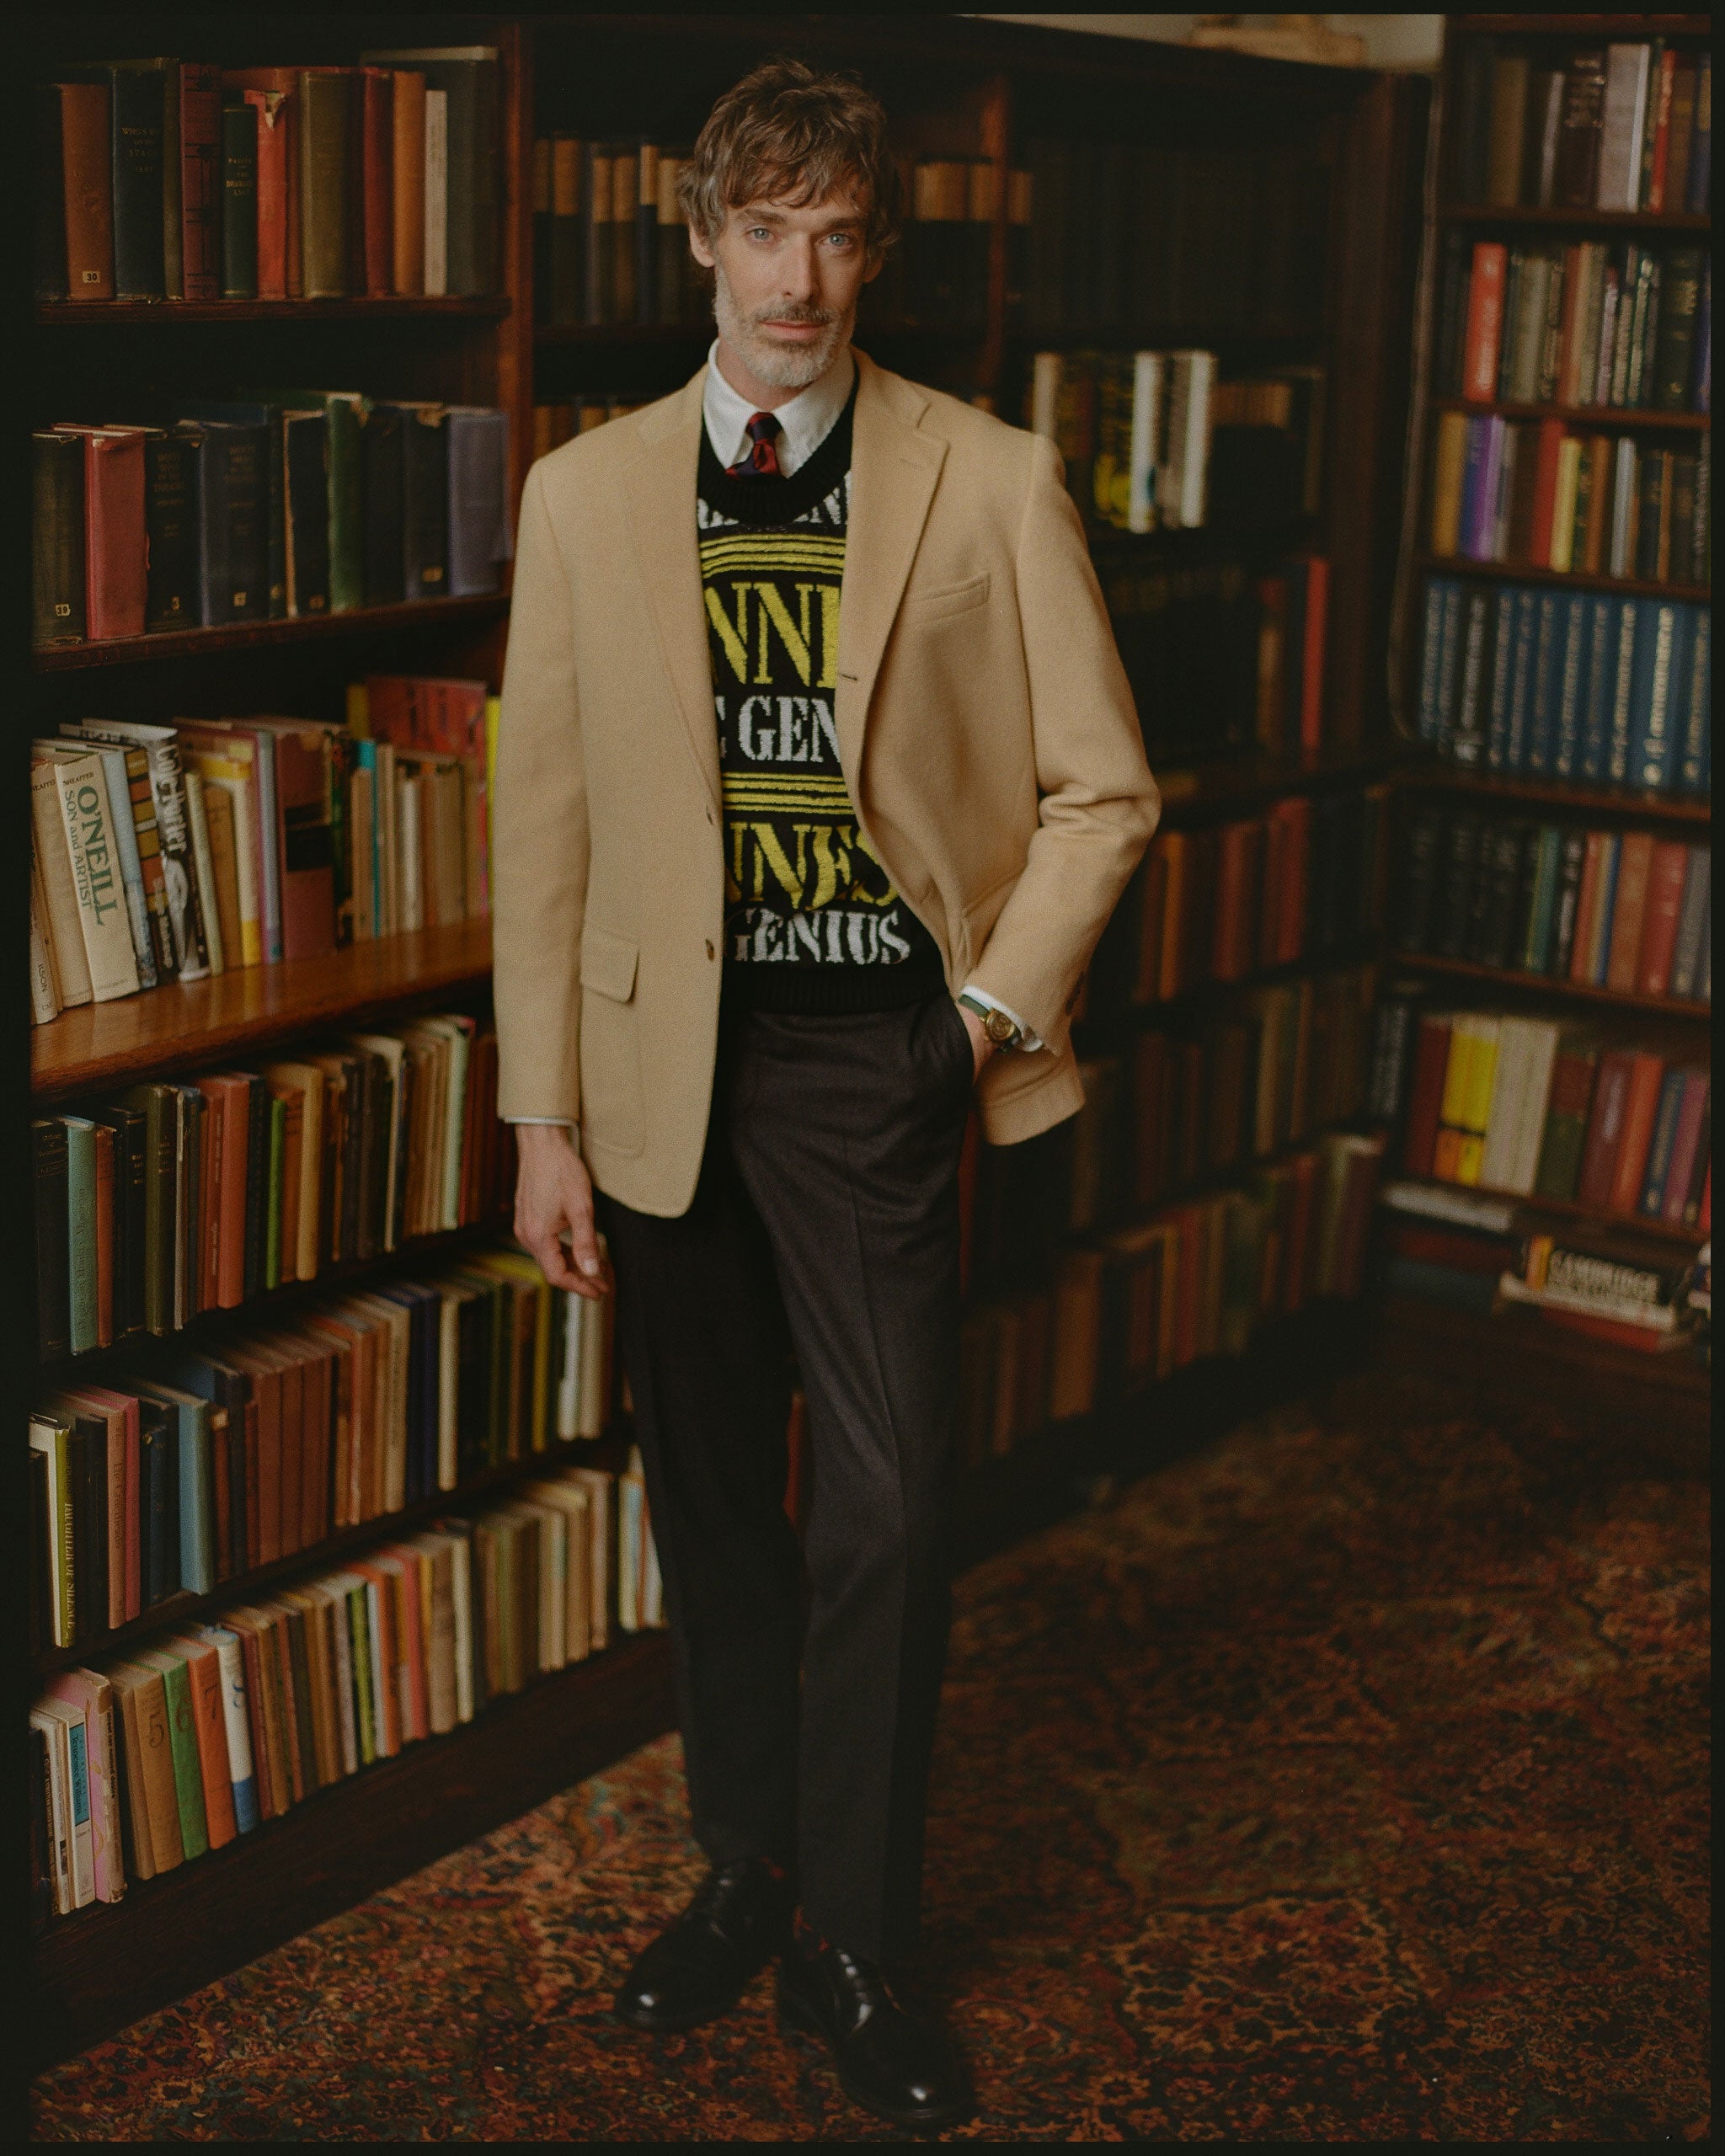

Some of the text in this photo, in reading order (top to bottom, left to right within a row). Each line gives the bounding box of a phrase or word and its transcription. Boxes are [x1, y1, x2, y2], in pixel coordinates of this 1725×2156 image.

[87, 273, 98, 281] 30
[56, 606, 68, 615] 39
[62, 771, 94, 786] SHEAFFER
[64, 790, 93, 910] SON and ARTIST
[77, 785, 118, 926] O'NEILL
[734, 907, 911, 965] GENIUS
[64, 1502, 76, 1629] DAUGHTER OF SILENCE
[148, 1710, 164, 1748] 5
